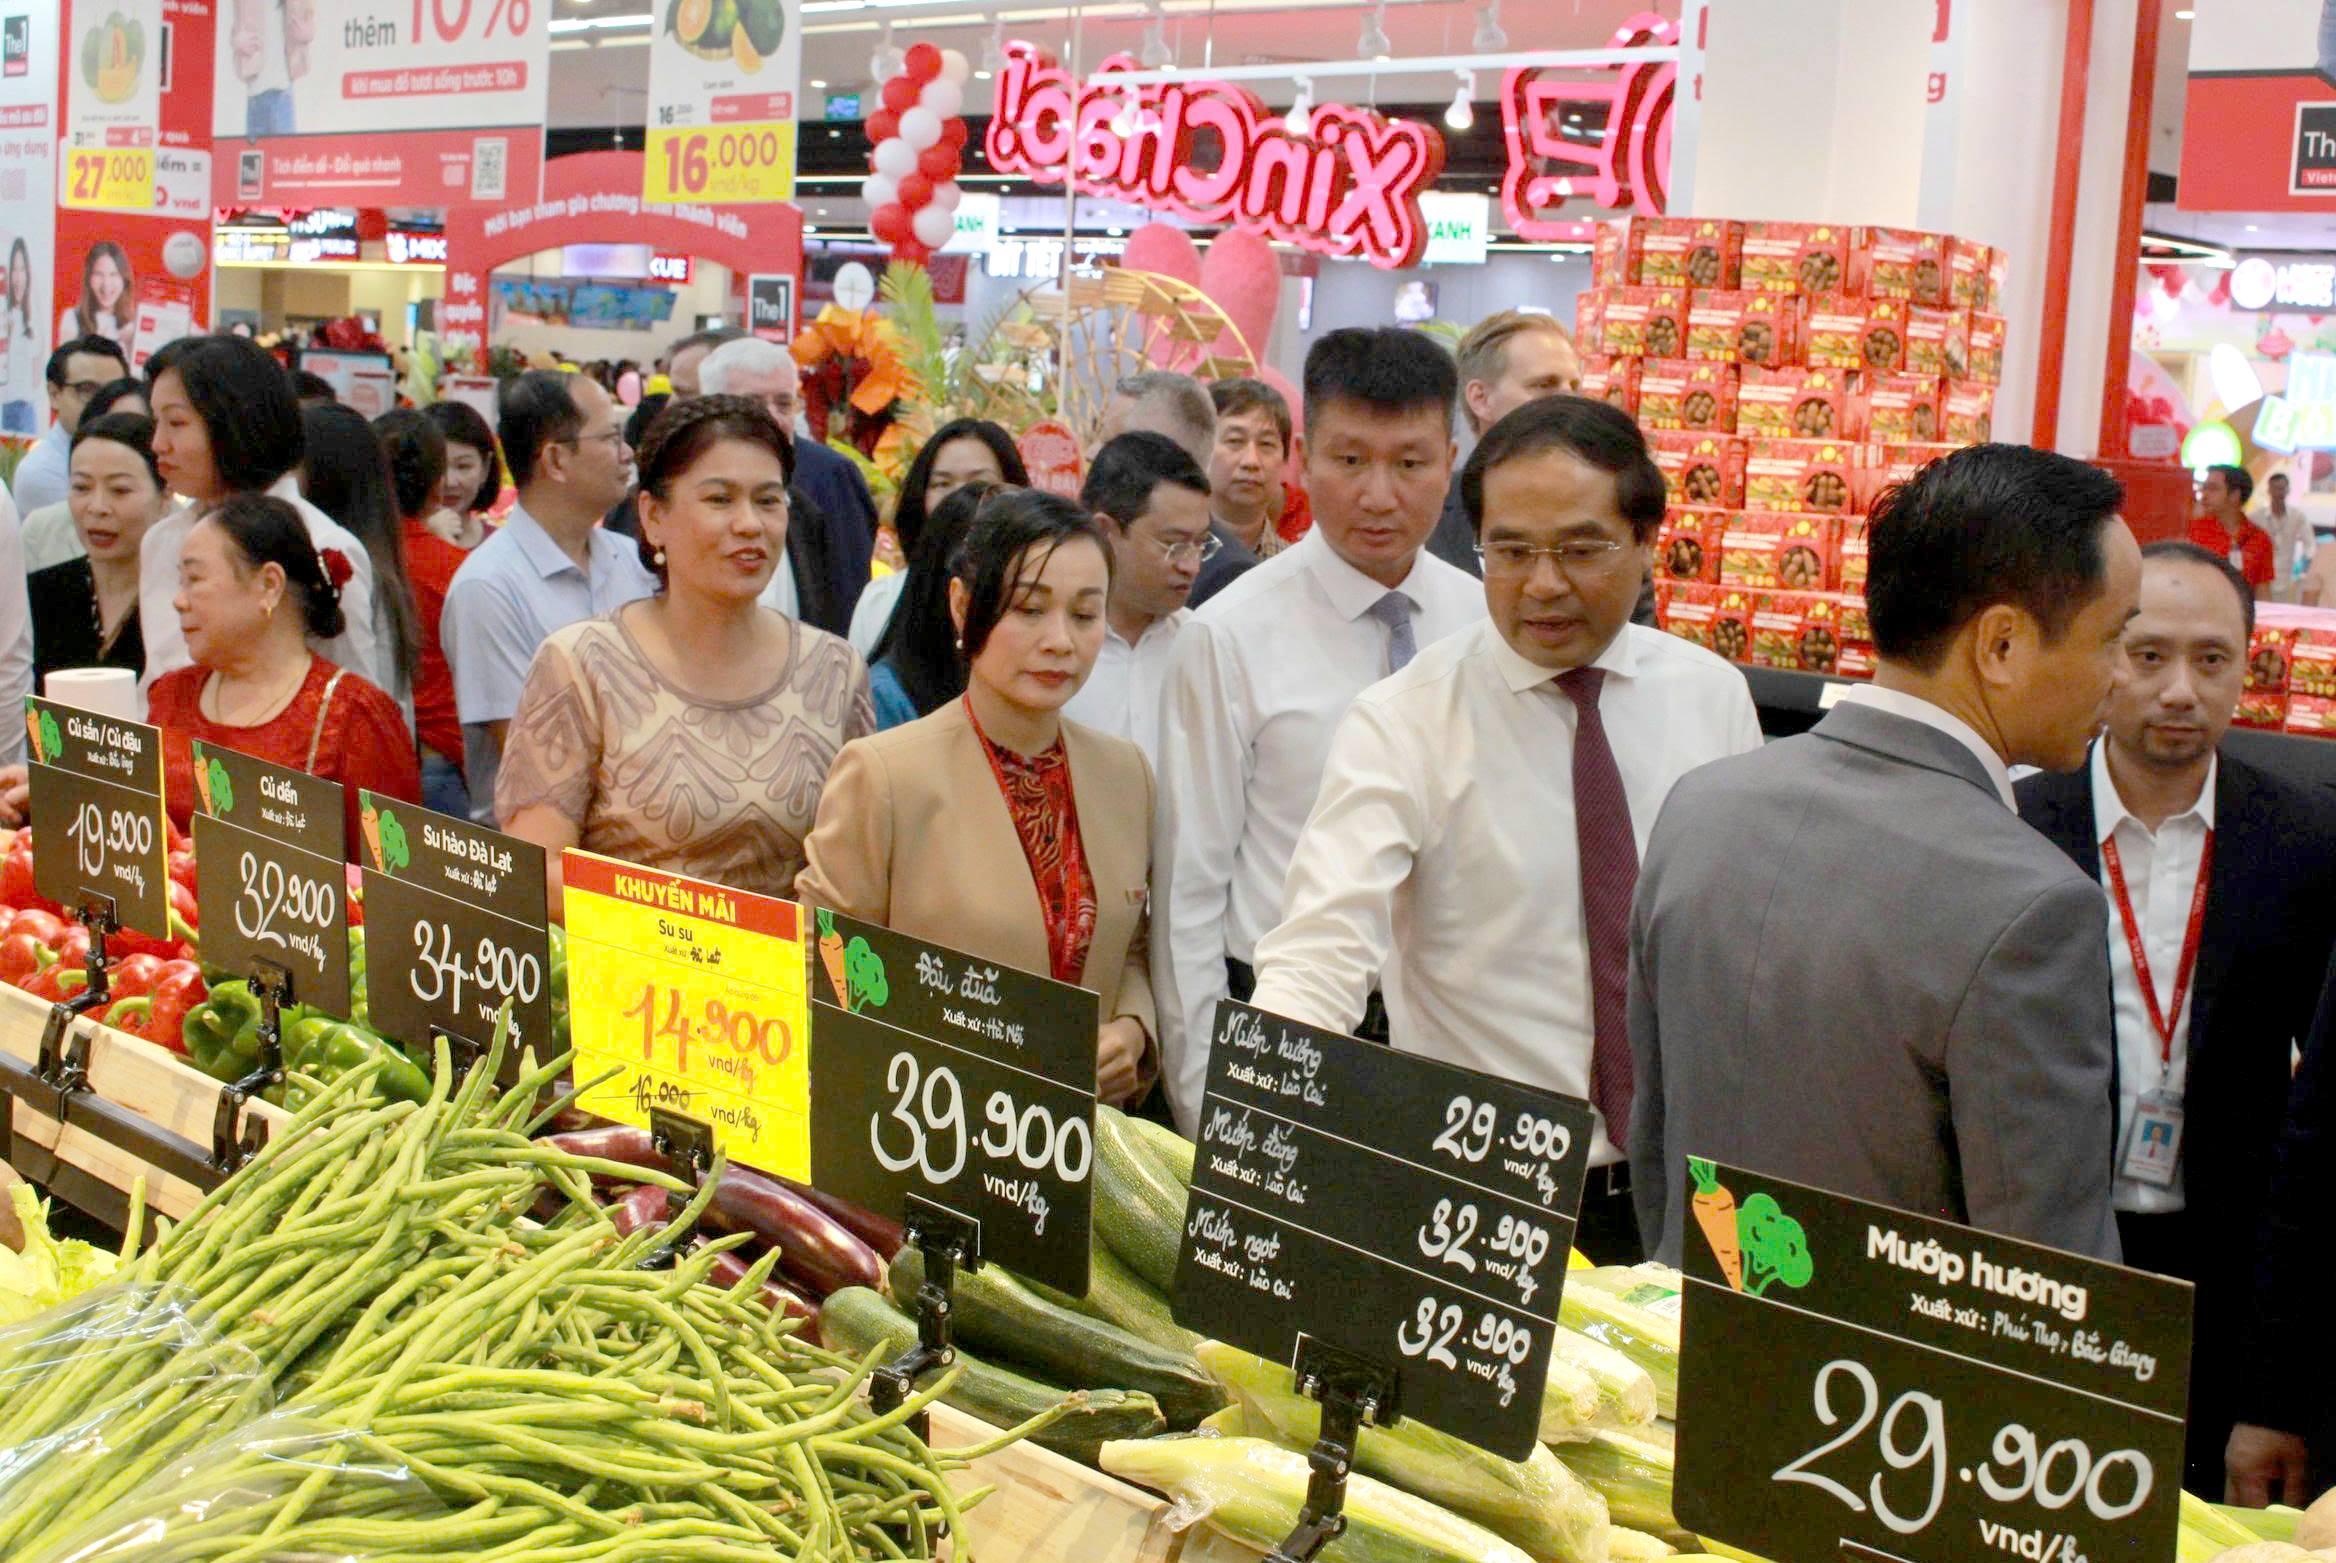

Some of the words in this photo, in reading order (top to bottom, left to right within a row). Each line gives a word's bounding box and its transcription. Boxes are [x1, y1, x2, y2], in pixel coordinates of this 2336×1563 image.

[344, 16, 397, 48] thêm
[664, 131, 778, 194] 16.000
[2304, 131, 2336, 158] Th
[68, 717, 81, 738] Củ
[107, 727, 121, 748] Củ
[122, 731, 142, 756] đậu
[260, 775, 275, 798] Củ
[66, 802, 152, 877] 19.900
[424, 824, 440, 848] Su
[442, 829, 467, 857] hào
[469, 839, 488, 865] Đà
[490, 845, 512, 877] Lạt
[235, 851, 335, 948] 32.900
[614, 873, 694, 913] KHUYẾN
[698, 893, 736, 923] MÃI
[658, 919, 675, 937] Su
[678, 927, 693, 942] su
[410, 919, 541, 1014] 34.900
[915, 951, 954, 998] Đậu
[478, 1003, 521, 1049] vndkg
[623, 983, 791, 1073] 14.900
[943, 1007, 966, 1028] Xuất
[986, 1017, 1004, 1040] Hà
[629, 1073, 690, 1114] 16.000
[1227, 1061, 1256, 1085] Xuất
[1280, 1069, 1300, 1095] Lào
[1303, 1080, 1327, 1107] Cai
[711, 1105, 762, 1143] vnd/kg
[871, 1052, 1092, 1185] 39.900
[1432, 1096, 1571, 1163] 29.900
[1261, 1123, 1299, 1173] đắng
[982, 1171, 1049, 1237] vnd/kg
[1210, 1154, 1239, 1178] Xuất
[1264, 1170, 1284, 1195] Lào
[1286, 1179, 1308, 1204] Cai
[1244, 1231, 1281, 1263] ngọt
[1418, 1198, 1549, 1273] 32.900
[1194, 1246, 1222, 1271] Xuất
[1249, 1267, 1270, 1291] Lào
[1273, 1278, 1295, 1300] Cai
[1867, 1225, 1965, 1286] Mướp
[1971, 1250, 2088, 1321] hương
[1398, 1296, 1532, 1371] 32.900
[1911, 1293, 1953, 1322] Xuất
[1992, 1310, 2031, 1342] Phú
[2071, 1328, 2108, 1364] Bắc
[2109, 1340, 2157, 1382] Giang
[1771, 1359, 2154, 1534] 29.900
